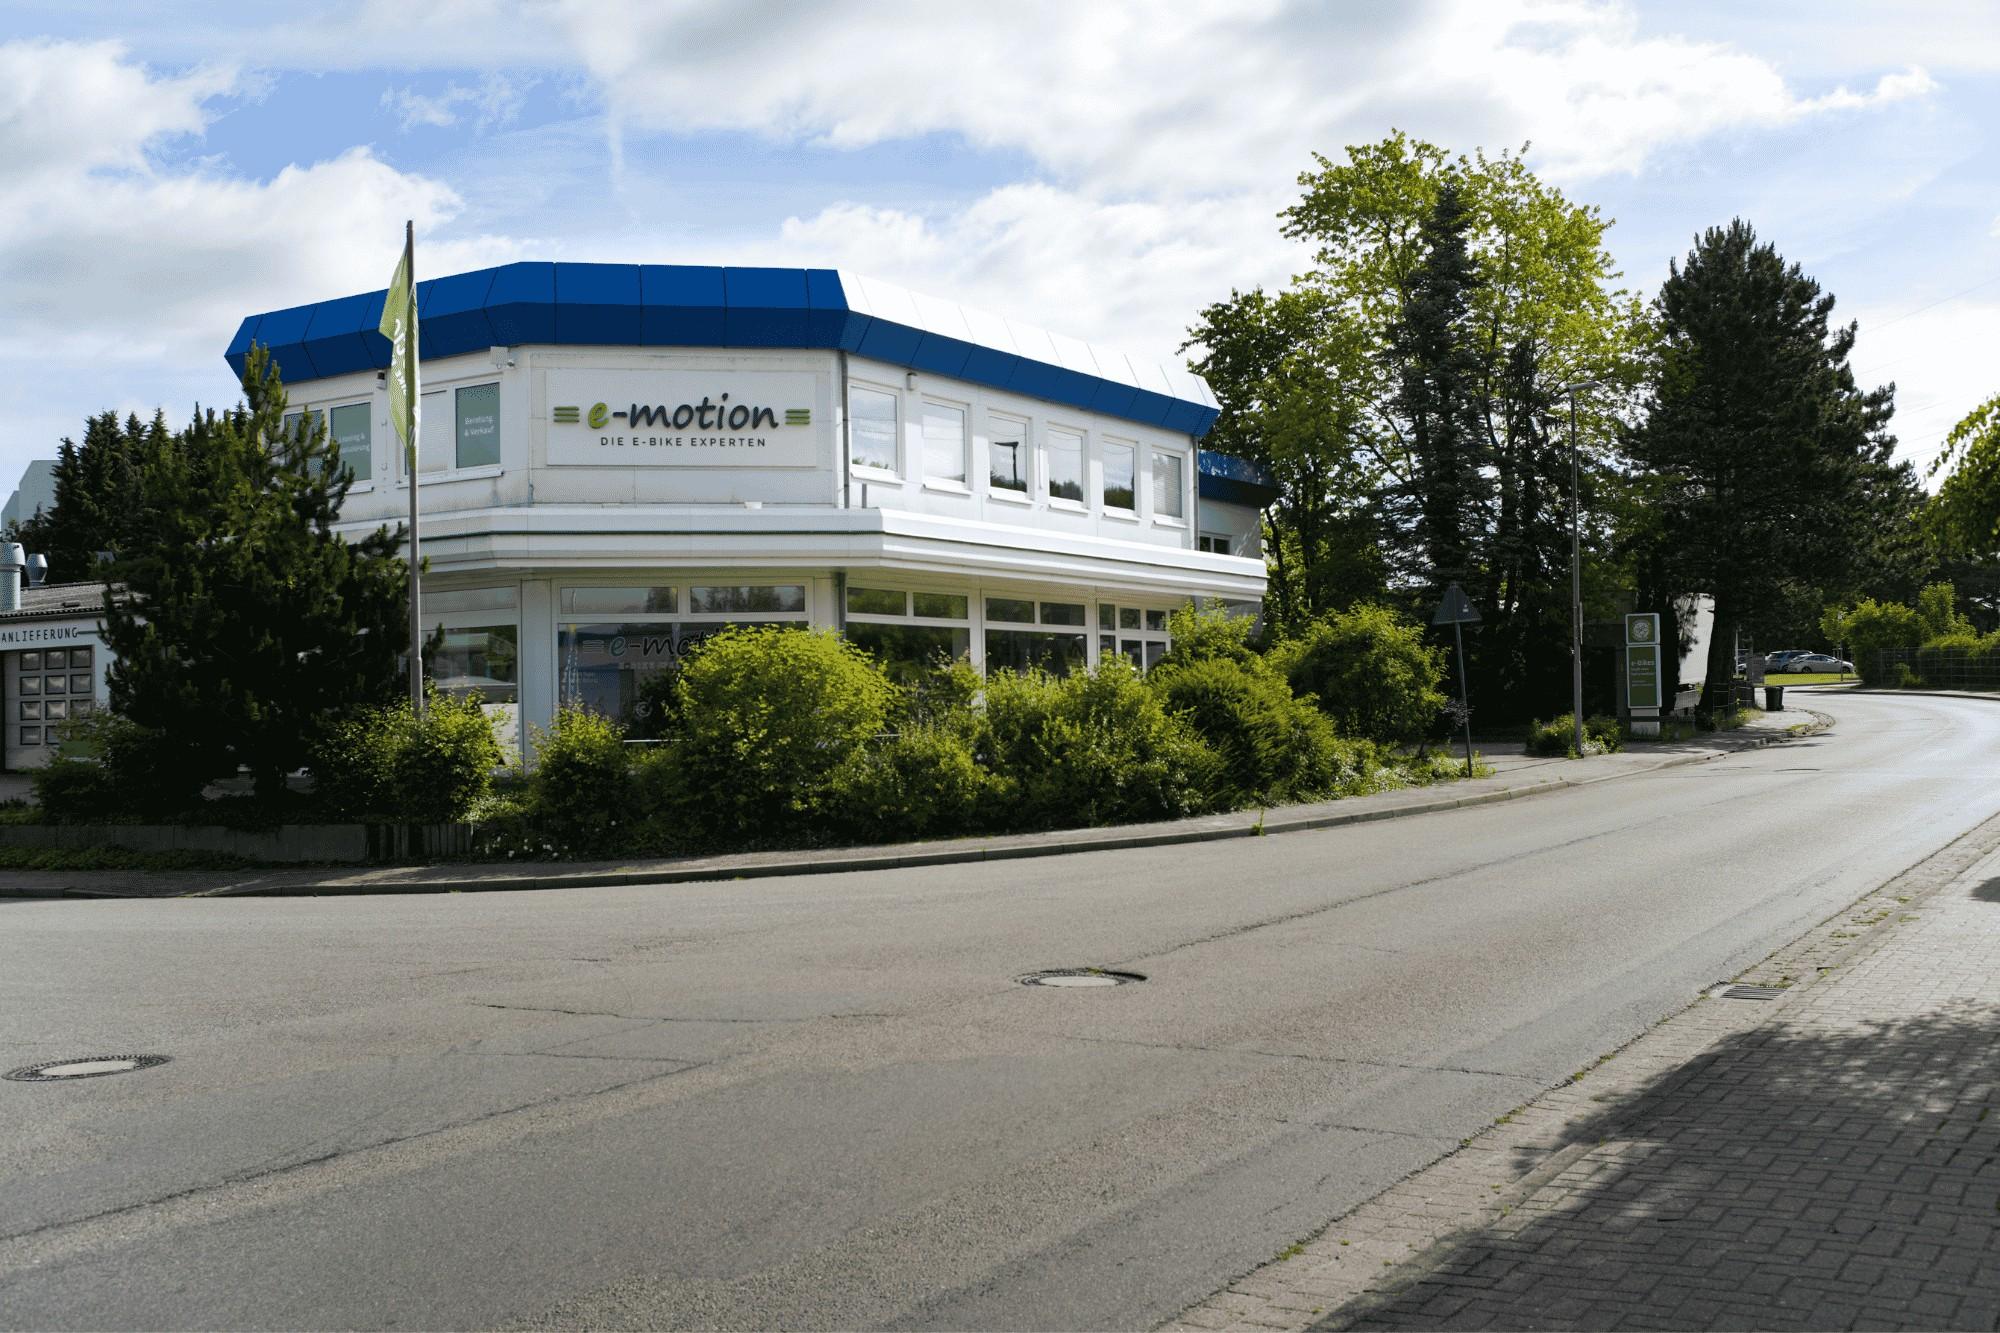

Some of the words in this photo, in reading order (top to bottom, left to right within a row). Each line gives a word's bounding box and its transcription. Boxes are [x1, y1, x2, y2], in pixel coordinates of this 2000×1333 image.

[588, 393, 779, 430] e-motion
[601, 437, 624, 446] DIE
[633, 437, 683, 446] E-BIKE
[691, 438, 766, 447] EXPERTEN
[1, 627, 78, 642] ANLIEFERUNG
